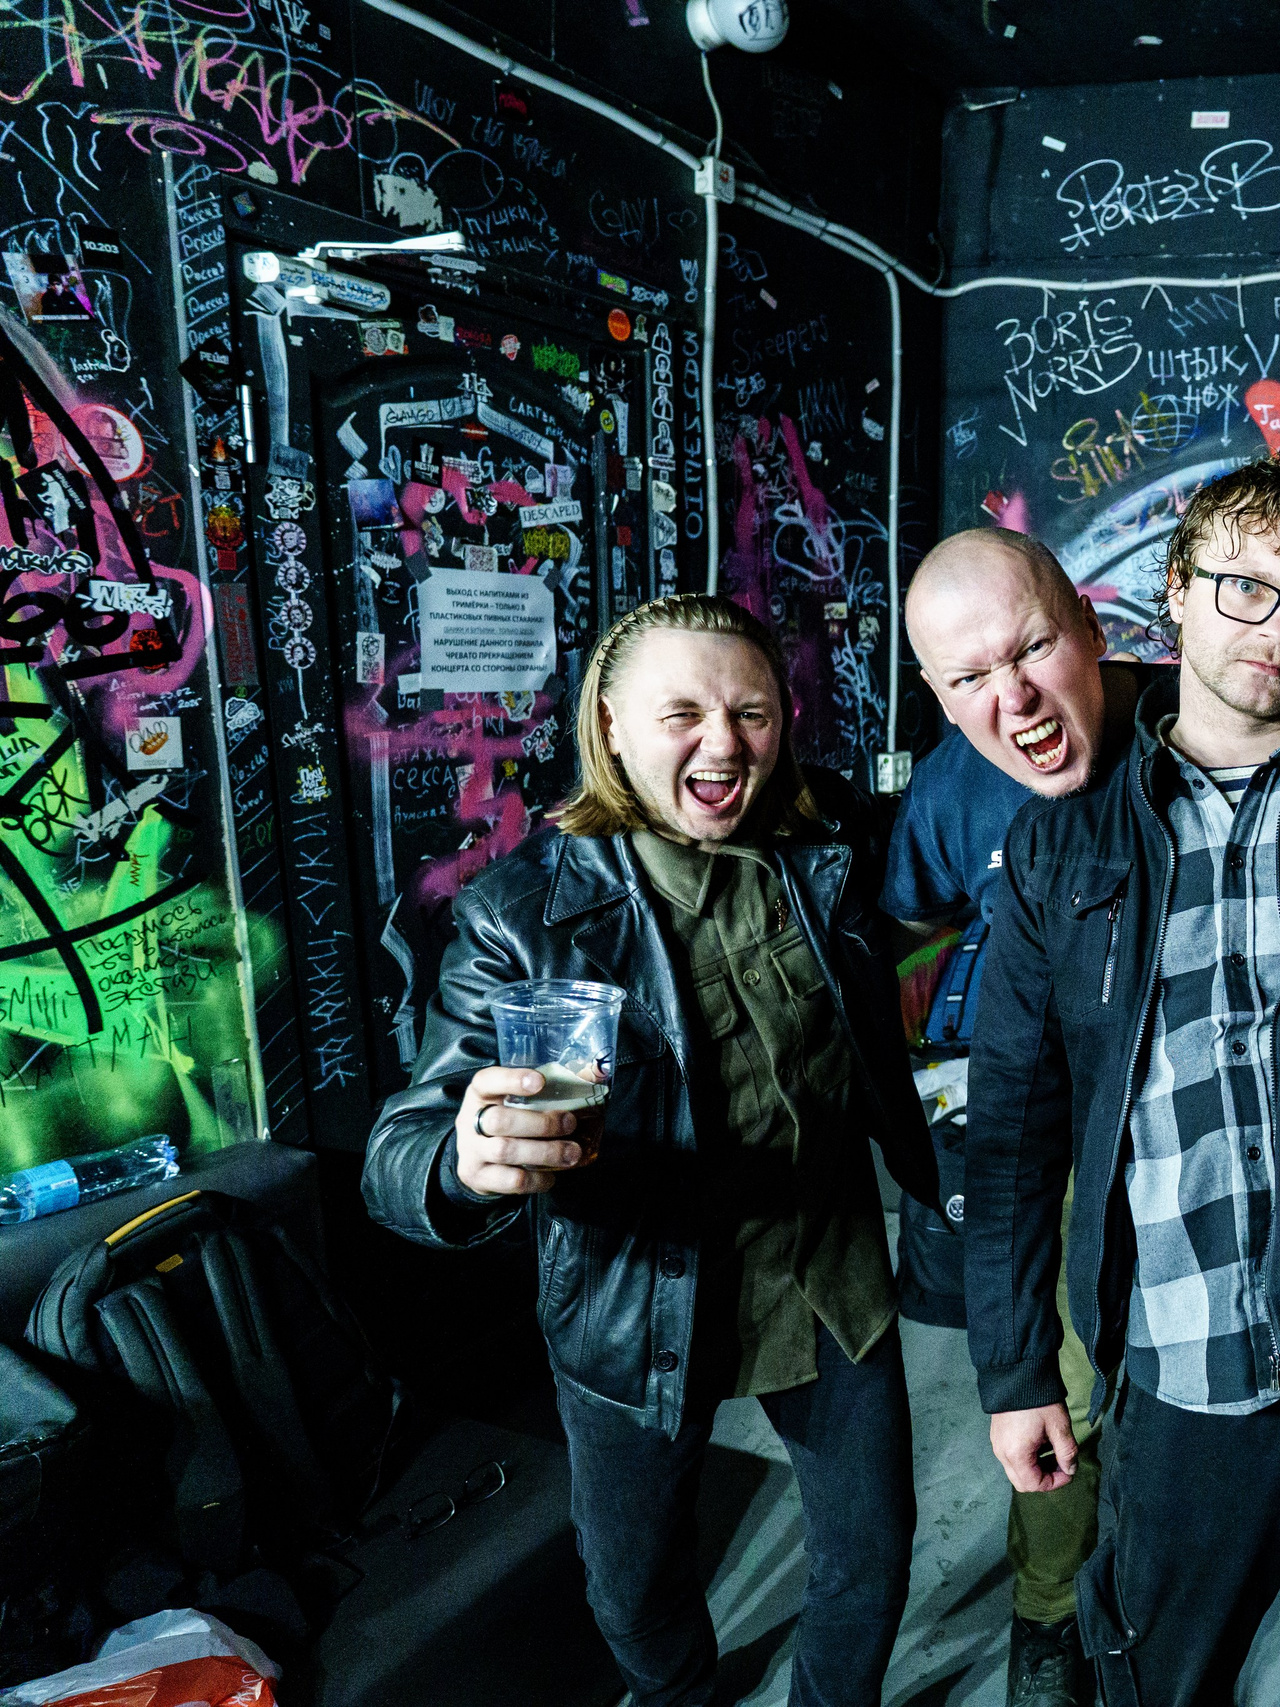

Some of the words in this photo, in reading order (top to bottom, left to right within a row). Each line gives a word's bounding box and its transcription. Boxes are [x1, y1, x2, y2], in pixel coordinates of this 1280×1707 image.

[446, 588, 472, 597] ВЫХОД
[479, 590, 520, 599] НАПИТКАМИ
[495, 602, 520, 611] ТОЛЬКО
[429, 612, 482, 621] ПЛАСТИКОВЫХ
[483, 614, 511, 622] ПИВНЫХ
[433, 639, 478, 647] НАРУШЕНИЕ
[479, 639, 513, 648] ДАННОГО
[445, 652, 477, 660] ЧРЕВАТО
[479, 652, 534, 660] ПРЕКРАЩЕНИЕМ
[431, 665, 470, 673] КОНЦЕРТА
